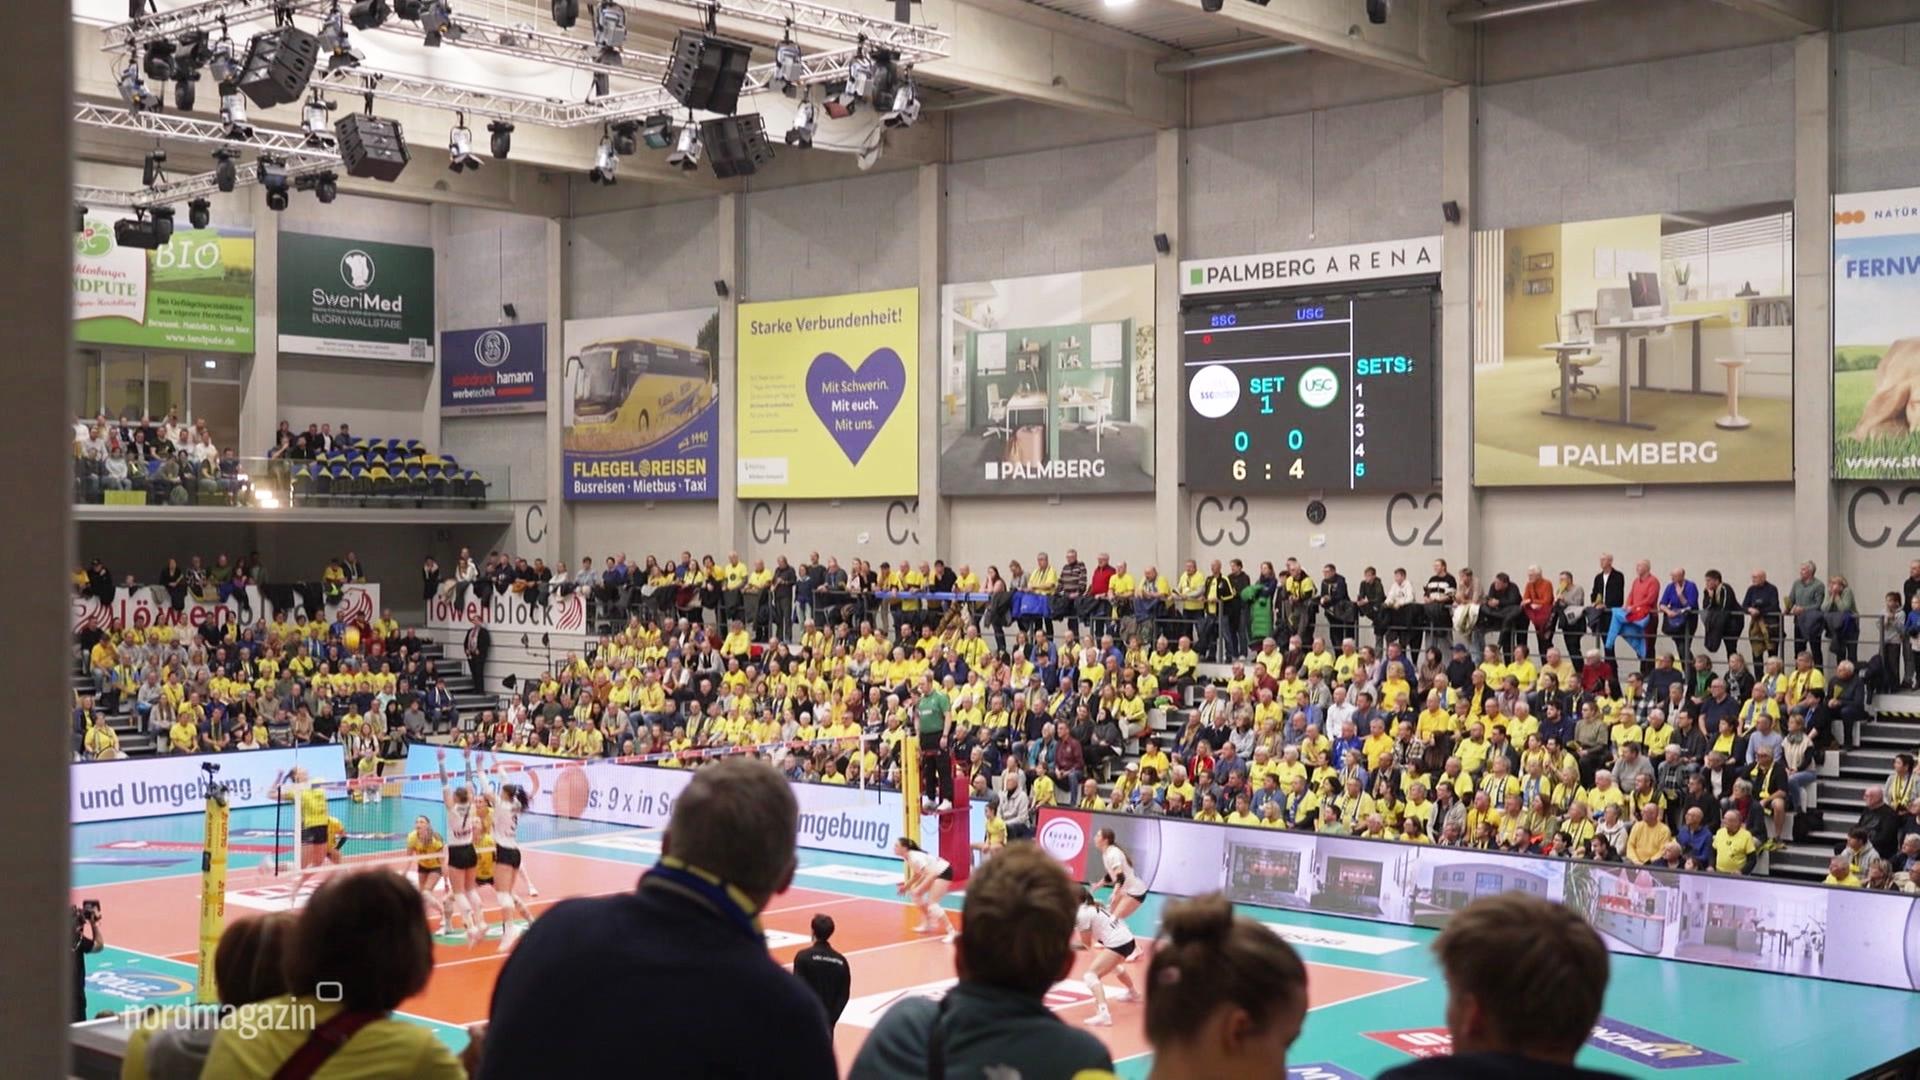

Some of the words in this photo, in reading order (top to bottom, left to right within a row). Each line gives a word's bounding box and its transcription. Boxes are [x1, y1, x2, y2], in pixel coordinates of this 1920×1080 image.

[156, 240, 220, 269] BIO
[1207, 258, 1315, 284] PALMBERG
[1326, 246, 1431, 274] ARENA
[312, 288, 402, 312] SweriMed
[751, 318, 792, 336] Starke
[796, 307, 903, 332] Verbundenheit!
[1211, 314, 1237, 327] SSC
[1296, 307, 1324, 320] USC
[1357, 356, 1414, 376] SETS:
[497, 371, 534, 384] hamann
[822, 381, 839, 394] Mit
[841, 379, 889, 393] Schwerin.
[1250, 376, 1285, 394] SET
[1356, 384, 1364, 397] 1
[831, 400, 849, 412] Mit
[852, 397, 879, 411] euch.
[1261, 395, 1273, 414] 1
[1355, 404, 1365, 418] 2
[835, 419, 853, 432] Mit
[855, 419, 875, 430] uns.
[1355, 424, 1365, 437] 3
[1234, 431, 1249, 452] 0
[1288, 429, 1303, 451] 0
[1355, 443, 1365, 457] 4
[1563, 441, 1718, 467] PALMBERG
[573, 461, 639, 478] FLAEGEL
[651, 459, 706, 475] REISEN
[1002, 459, 1105, 479] PALMBERG
[1232, 459, 1247, 481] 6
[1289, 459, 1304, 480] 4
[1355, 463, 1365, 477] 5
[574, 480, 625, 494] Busreisen
[633, 479, 676, 493] Mietbus
[684, 478, 706, 492] Taxi
[526, 504, 548, 544] C
[752, 502, 790, 544] C4
[1196, 496, 1250, 546] C3
[1386, 492, 1443, 546] C2
[1848, 486, 1920, 549] C2
[80, 783, 124, 810] und
[132, 776, 252, 807] Umgebng
[608, 787, 619, 810] 9
[623, 793, 633, 813] x
[638, 789, 653, 816] in
[798, 811, 890, 849] mgebung
